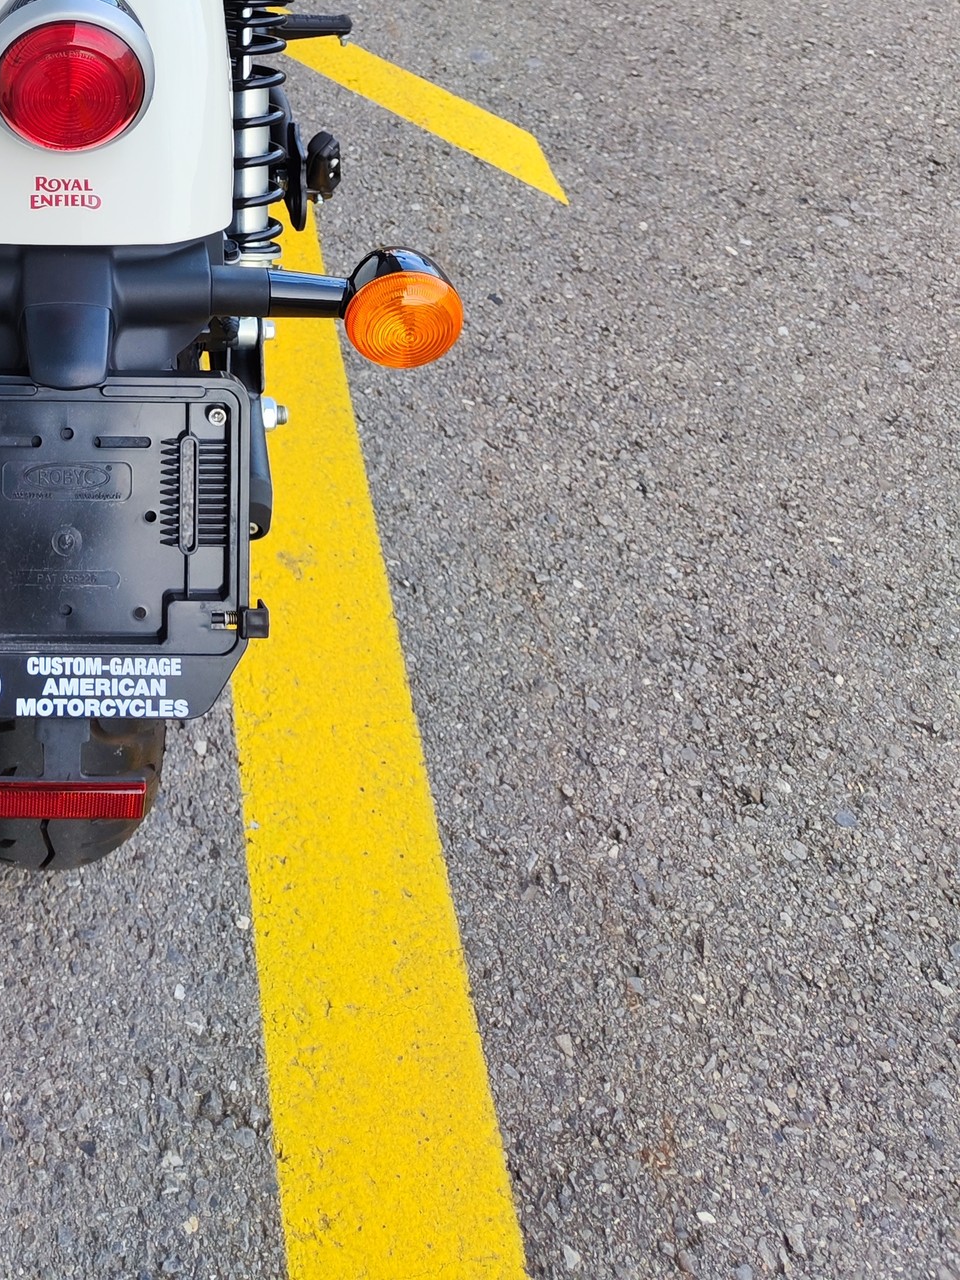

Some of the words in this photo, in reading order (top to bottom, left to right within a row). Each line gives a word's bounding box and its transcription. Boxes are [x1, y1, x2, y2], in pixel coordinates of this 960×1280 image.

[35, 176, 93, 193] ROYAL
[30, 194, 102, 210] ENFIELD
[27, 657, 182, 676] CUSTOM-GARAGE
[42, 678, 166, 697] AMERICAN
[16, 698, 189, 718] MOTORCYCLES
